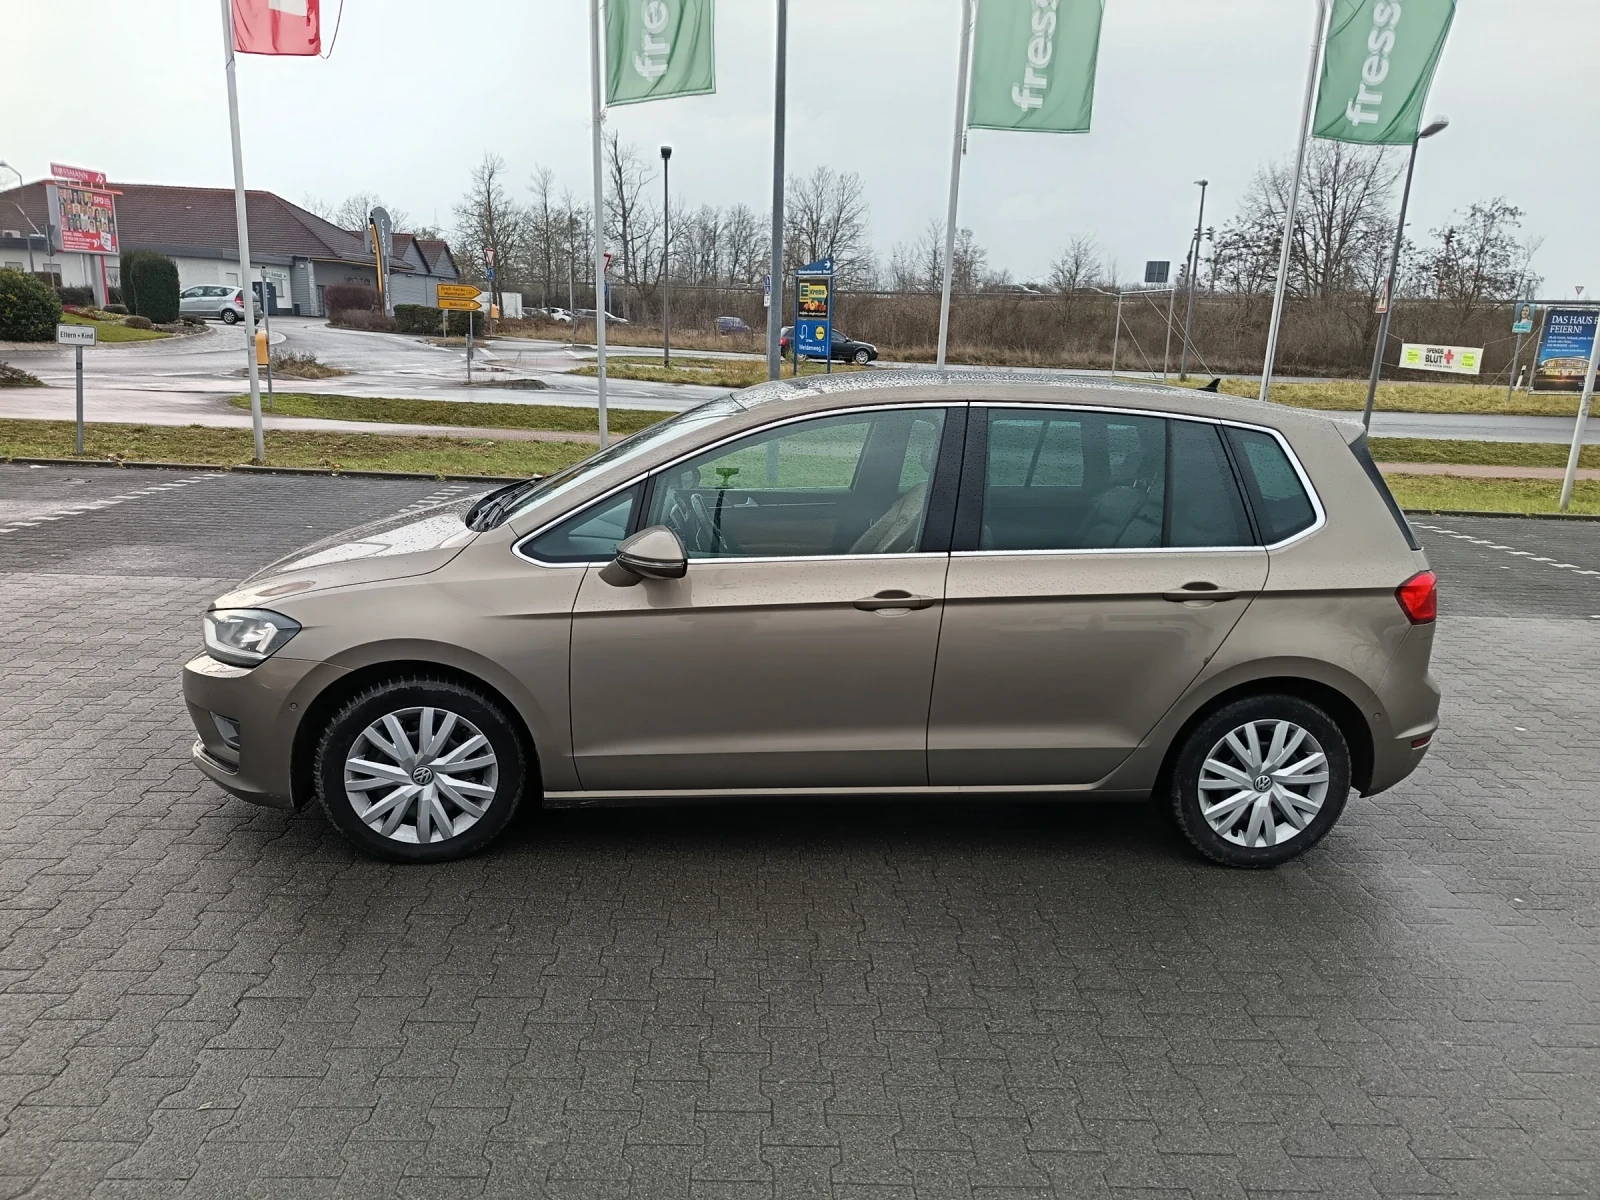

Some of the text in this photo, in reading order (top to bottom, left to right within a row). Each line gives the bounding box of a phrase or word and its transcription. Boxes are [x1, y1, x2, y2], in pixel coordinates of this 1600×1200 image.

[633, 0, 670, 82] fre
[53, 166, 88, 180] ROSSMANN
[93, 196, 104, 204] SPD
[1551, 315, 1568, 324] DAS
[1569, 315, 1593, 325] HAUS
[1549, 325, 1583, 333] FEIERN!
[1425, 354, 1443, 364] BLUT
